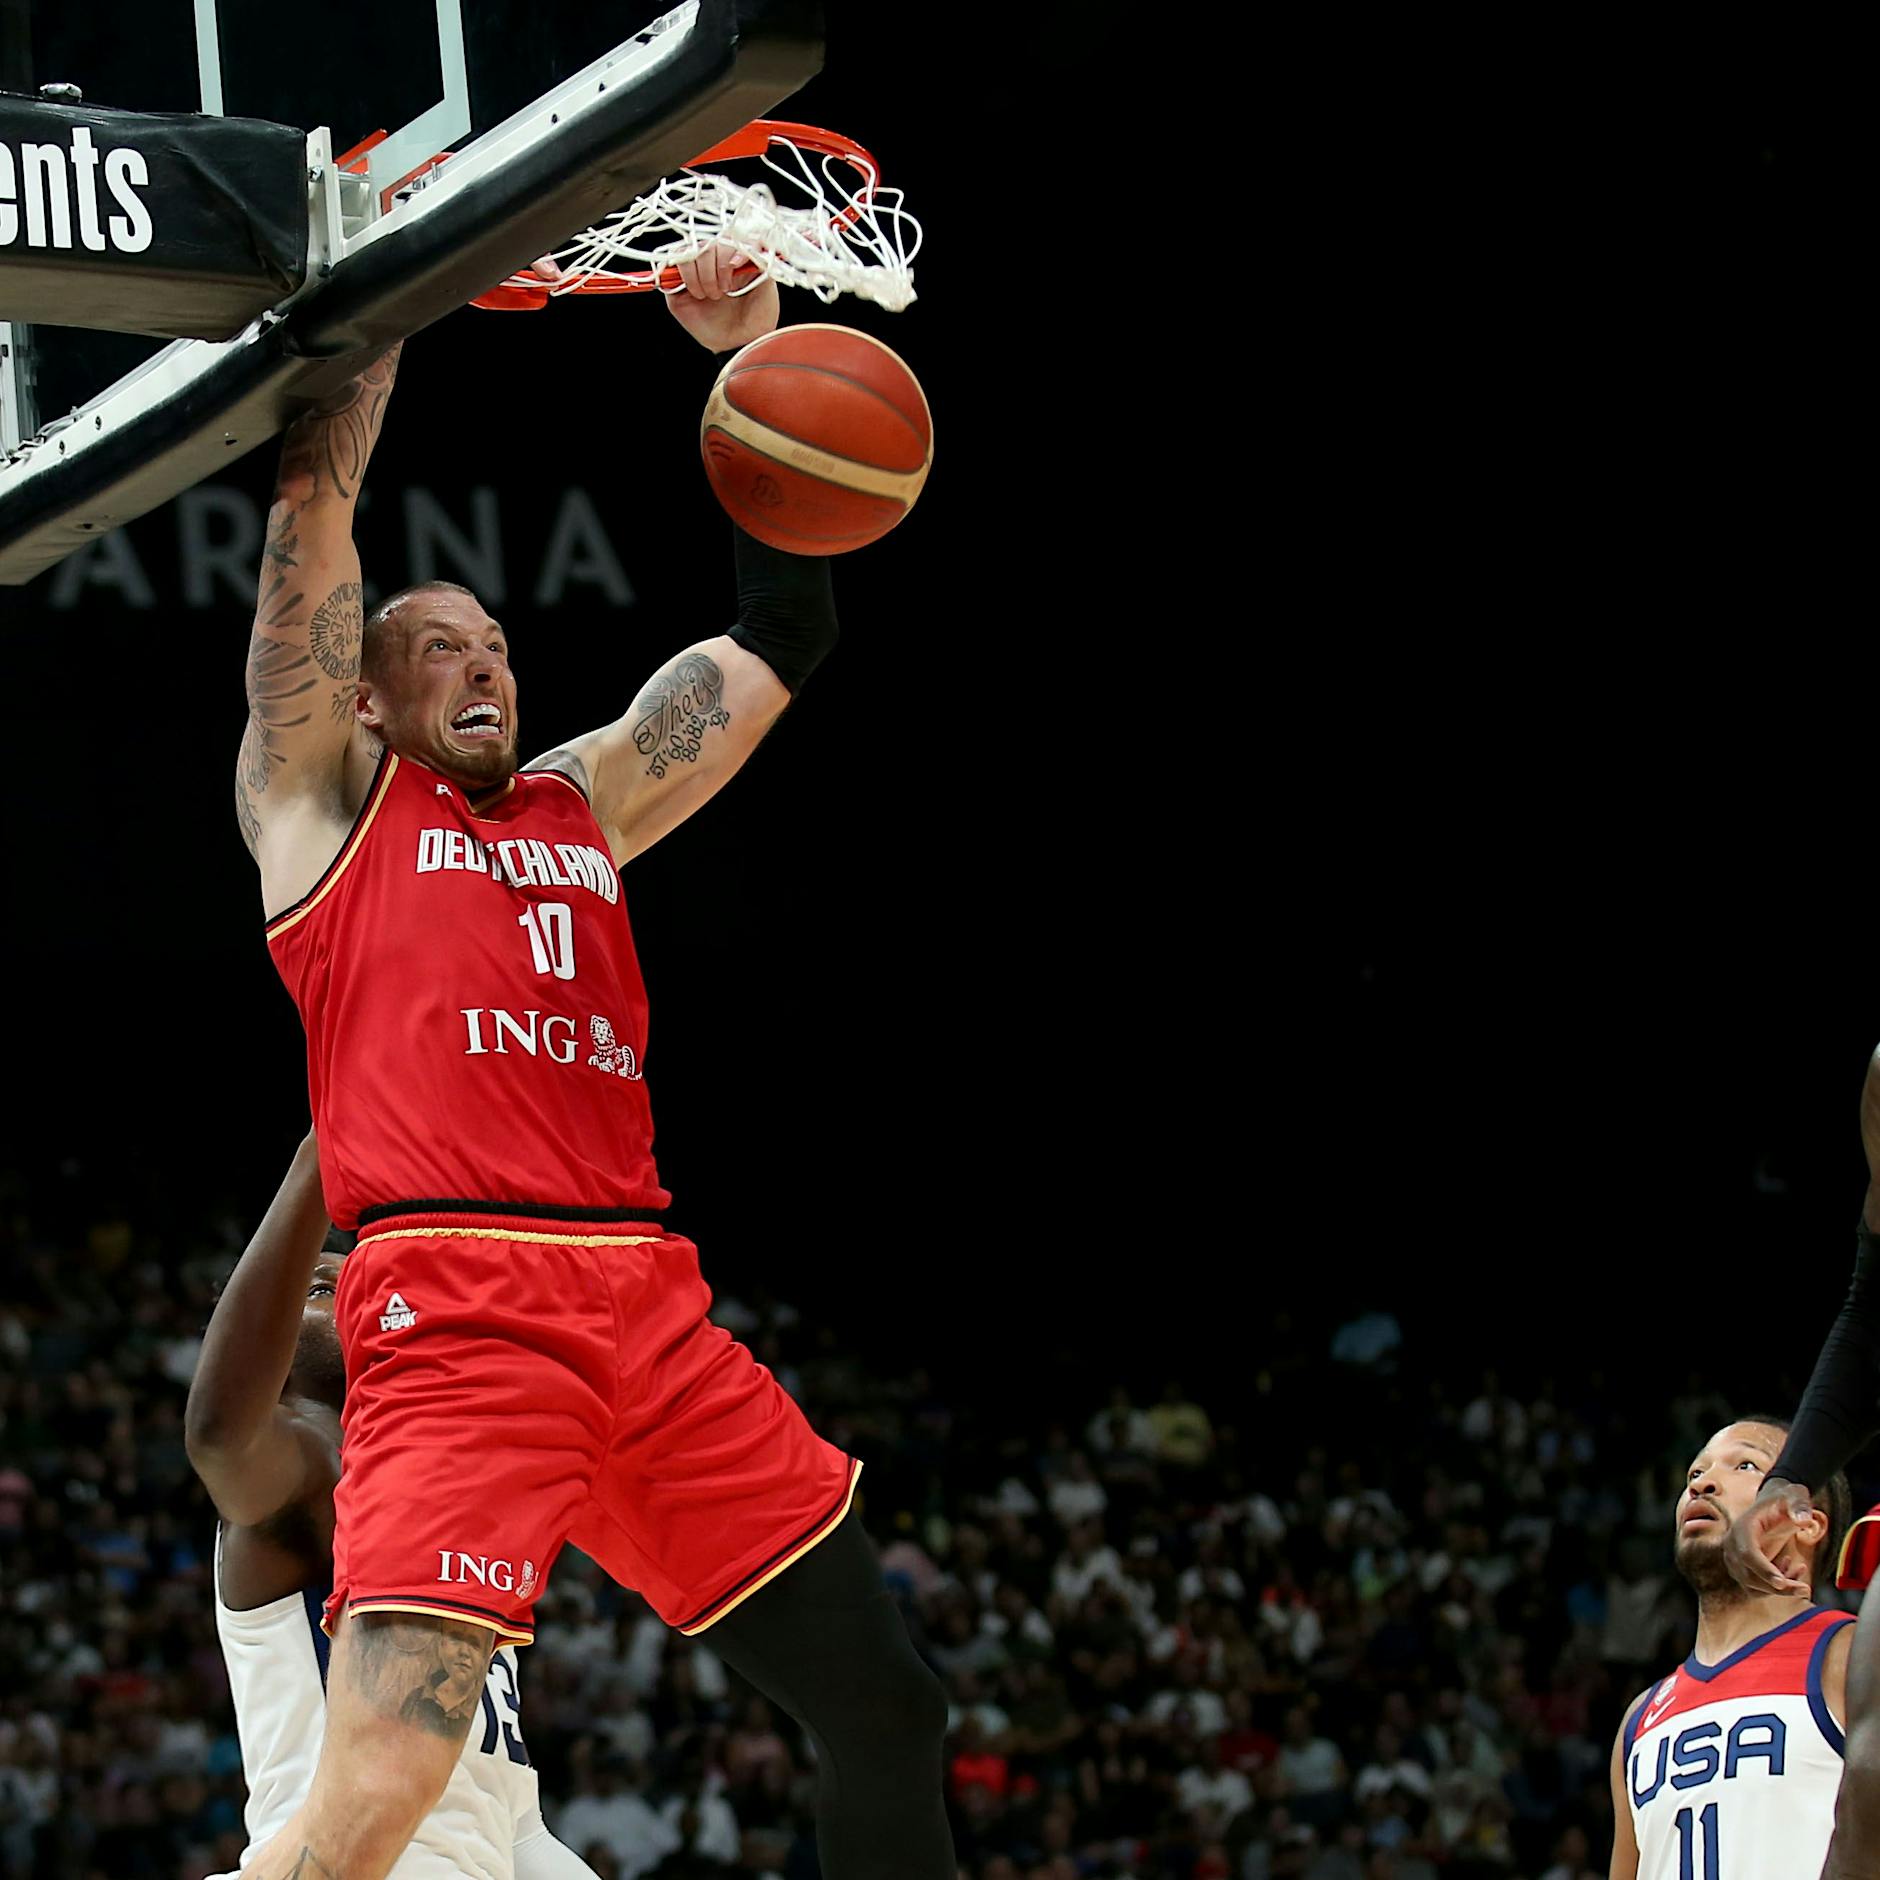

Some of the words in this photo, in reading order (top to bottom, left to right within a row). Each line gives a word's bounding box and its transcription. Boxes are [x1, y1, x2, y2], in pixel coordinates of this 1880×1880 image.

[50, 481, 634, 608] ARNA
[416, 828, 618, 905] DEUCHLAND
[518, 902, 575, 981] 10
[460, 1008, 579, 1064] ING
[379, 1310, 418, 1332] PEAK
[437, 1550, 514, 1591] ING
[1632, 1713, 1787, 1810] USA
[1674, 1802, 1720, 1880] 11
